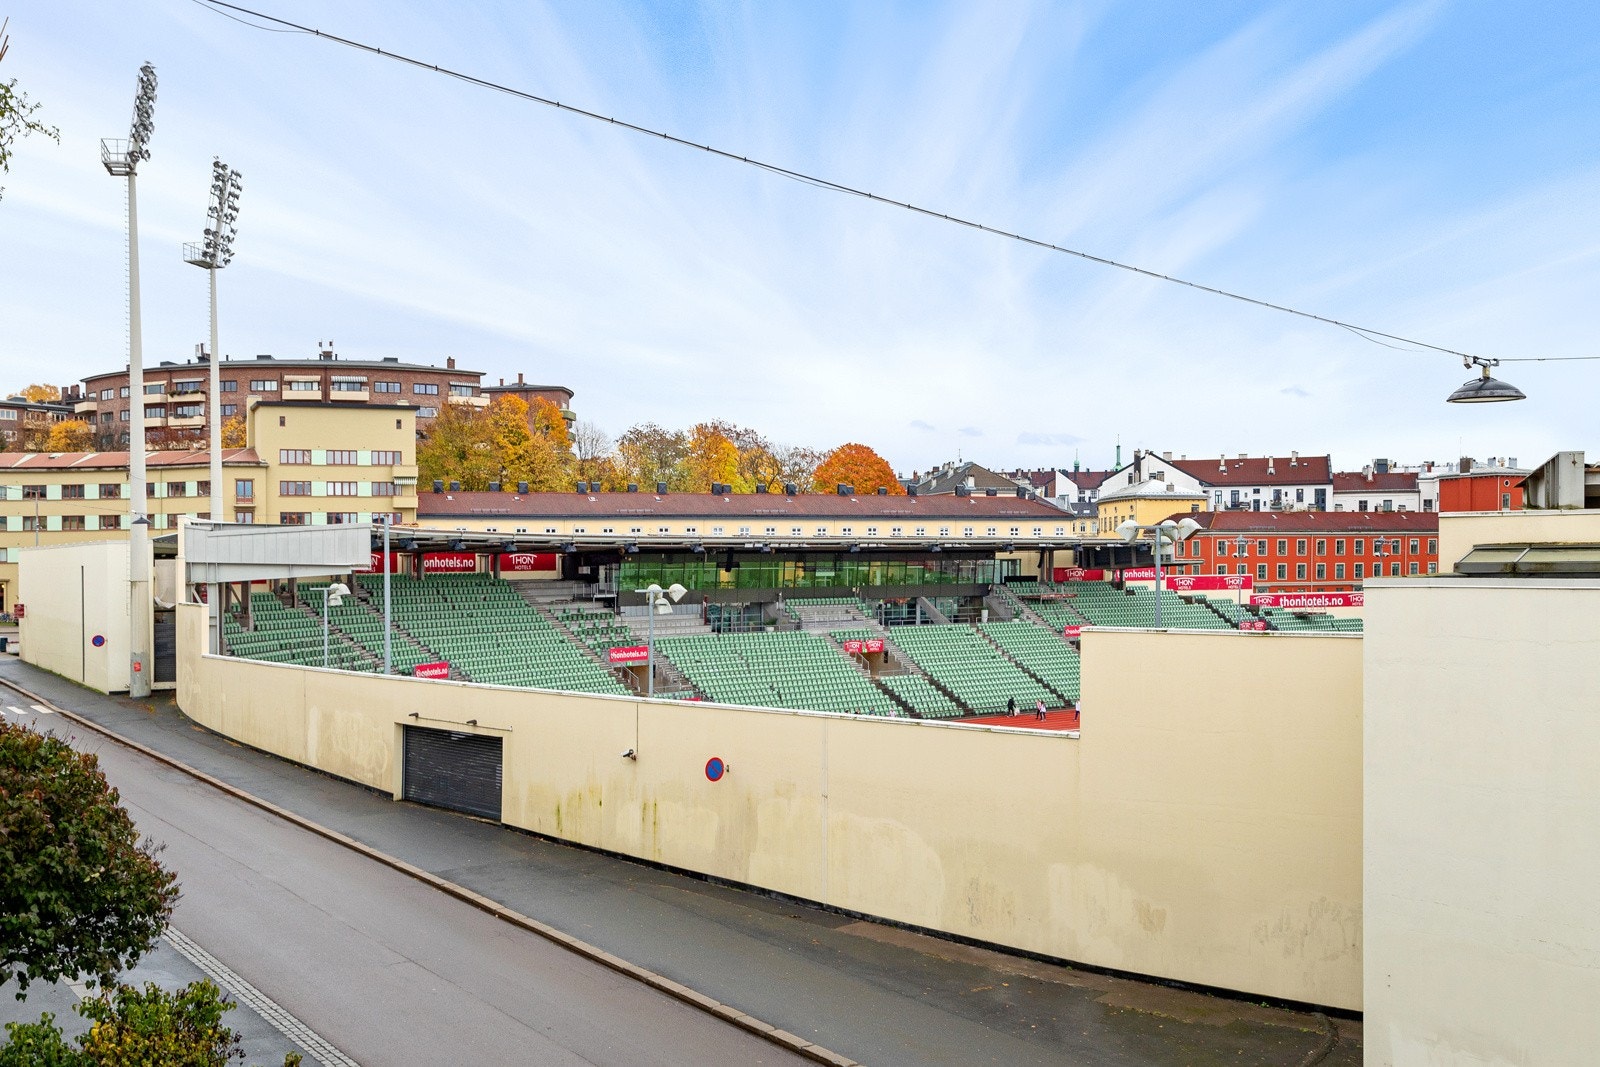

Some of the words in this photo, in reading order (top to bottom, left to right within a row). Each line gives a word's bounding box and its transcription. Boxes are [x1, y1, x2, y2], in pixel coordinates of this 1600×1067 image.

[415, 556, 474, 568] onhotels.no
[509, 554, 537, 564] THON
[1065, 568, 1087, 577] THON
[1117, 570, 1164, 578] tonhotels.o
[1174, 577, 1196, 586] THON
[1254, 596, 1274, 604] THON
[1280, 596, 1343, 607] thonhotels.no
[610, 651, 648, 659] thonhotels.no
